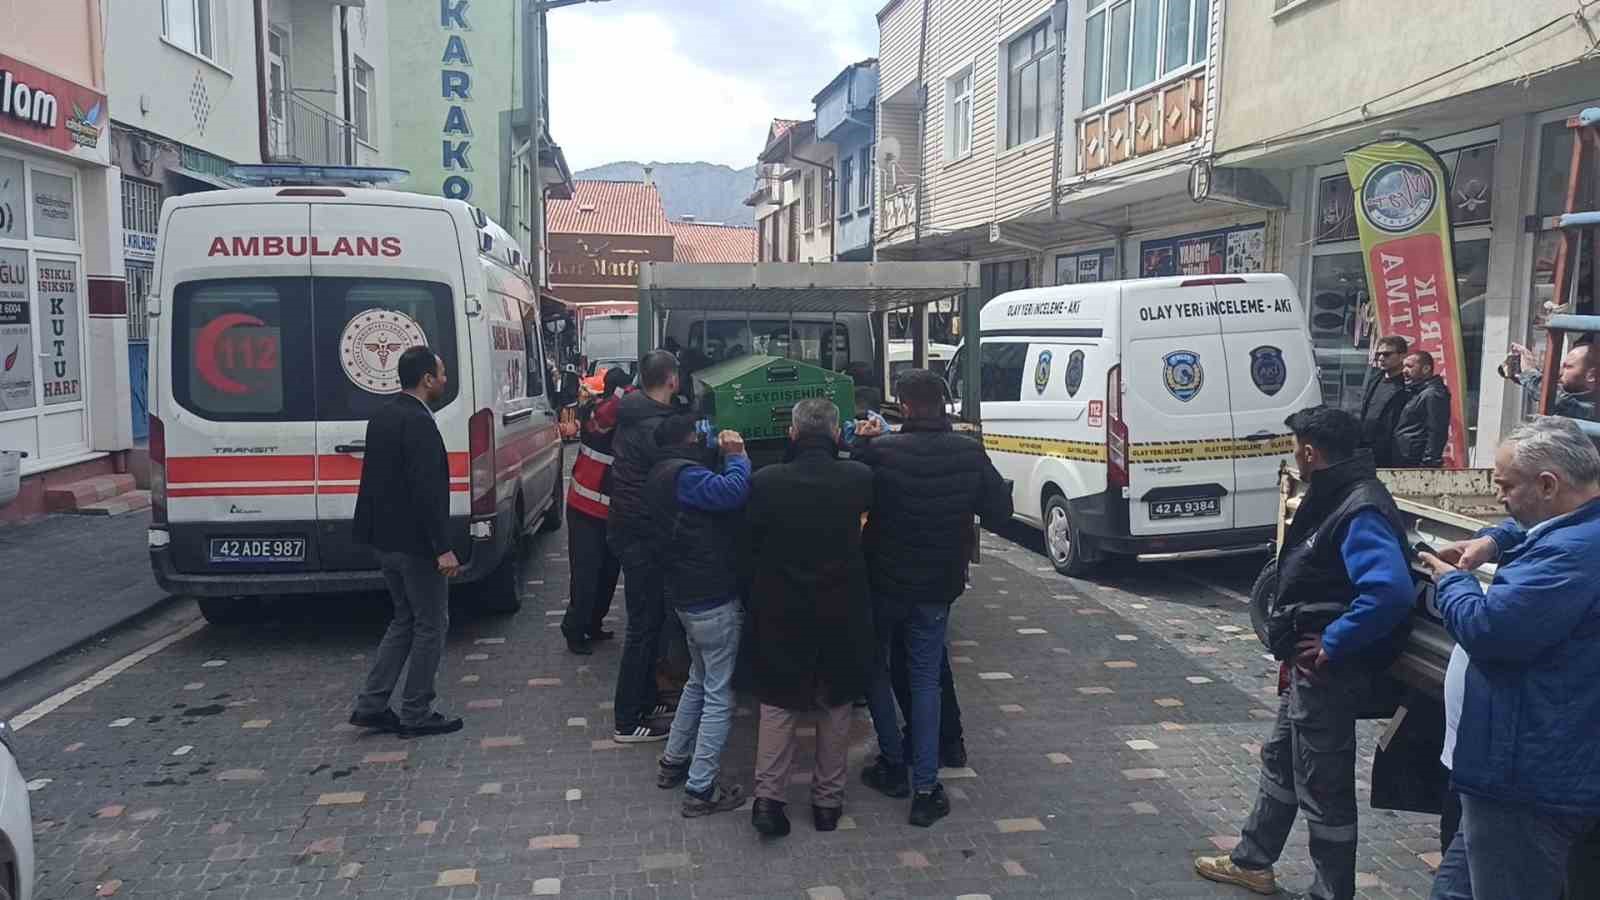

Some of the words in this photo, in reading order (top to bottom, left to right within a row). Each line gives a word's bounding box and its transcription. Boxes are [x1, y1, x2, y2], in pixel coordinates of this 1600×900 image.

[1, 72, 57, 127] lam
[208, 236, 402, 257] AMBULANS
[0, 260, 26, 285] ĞLU
[1139, 304, 1172, 321] OLAY
[48, 298, 66, 378] KUTU
[219, 334, 277, 370] 112
[43, 380, 79, 398] HARF
[1155, 504, 1171, 514] 42
[1174, 502, 1182, 513] A
[1185, 501, 1215, 511] 9384
[220, 541, 239, 556] 42
[242, 541, 271, 556] ADE
[273, 541, 302, 556] 987
